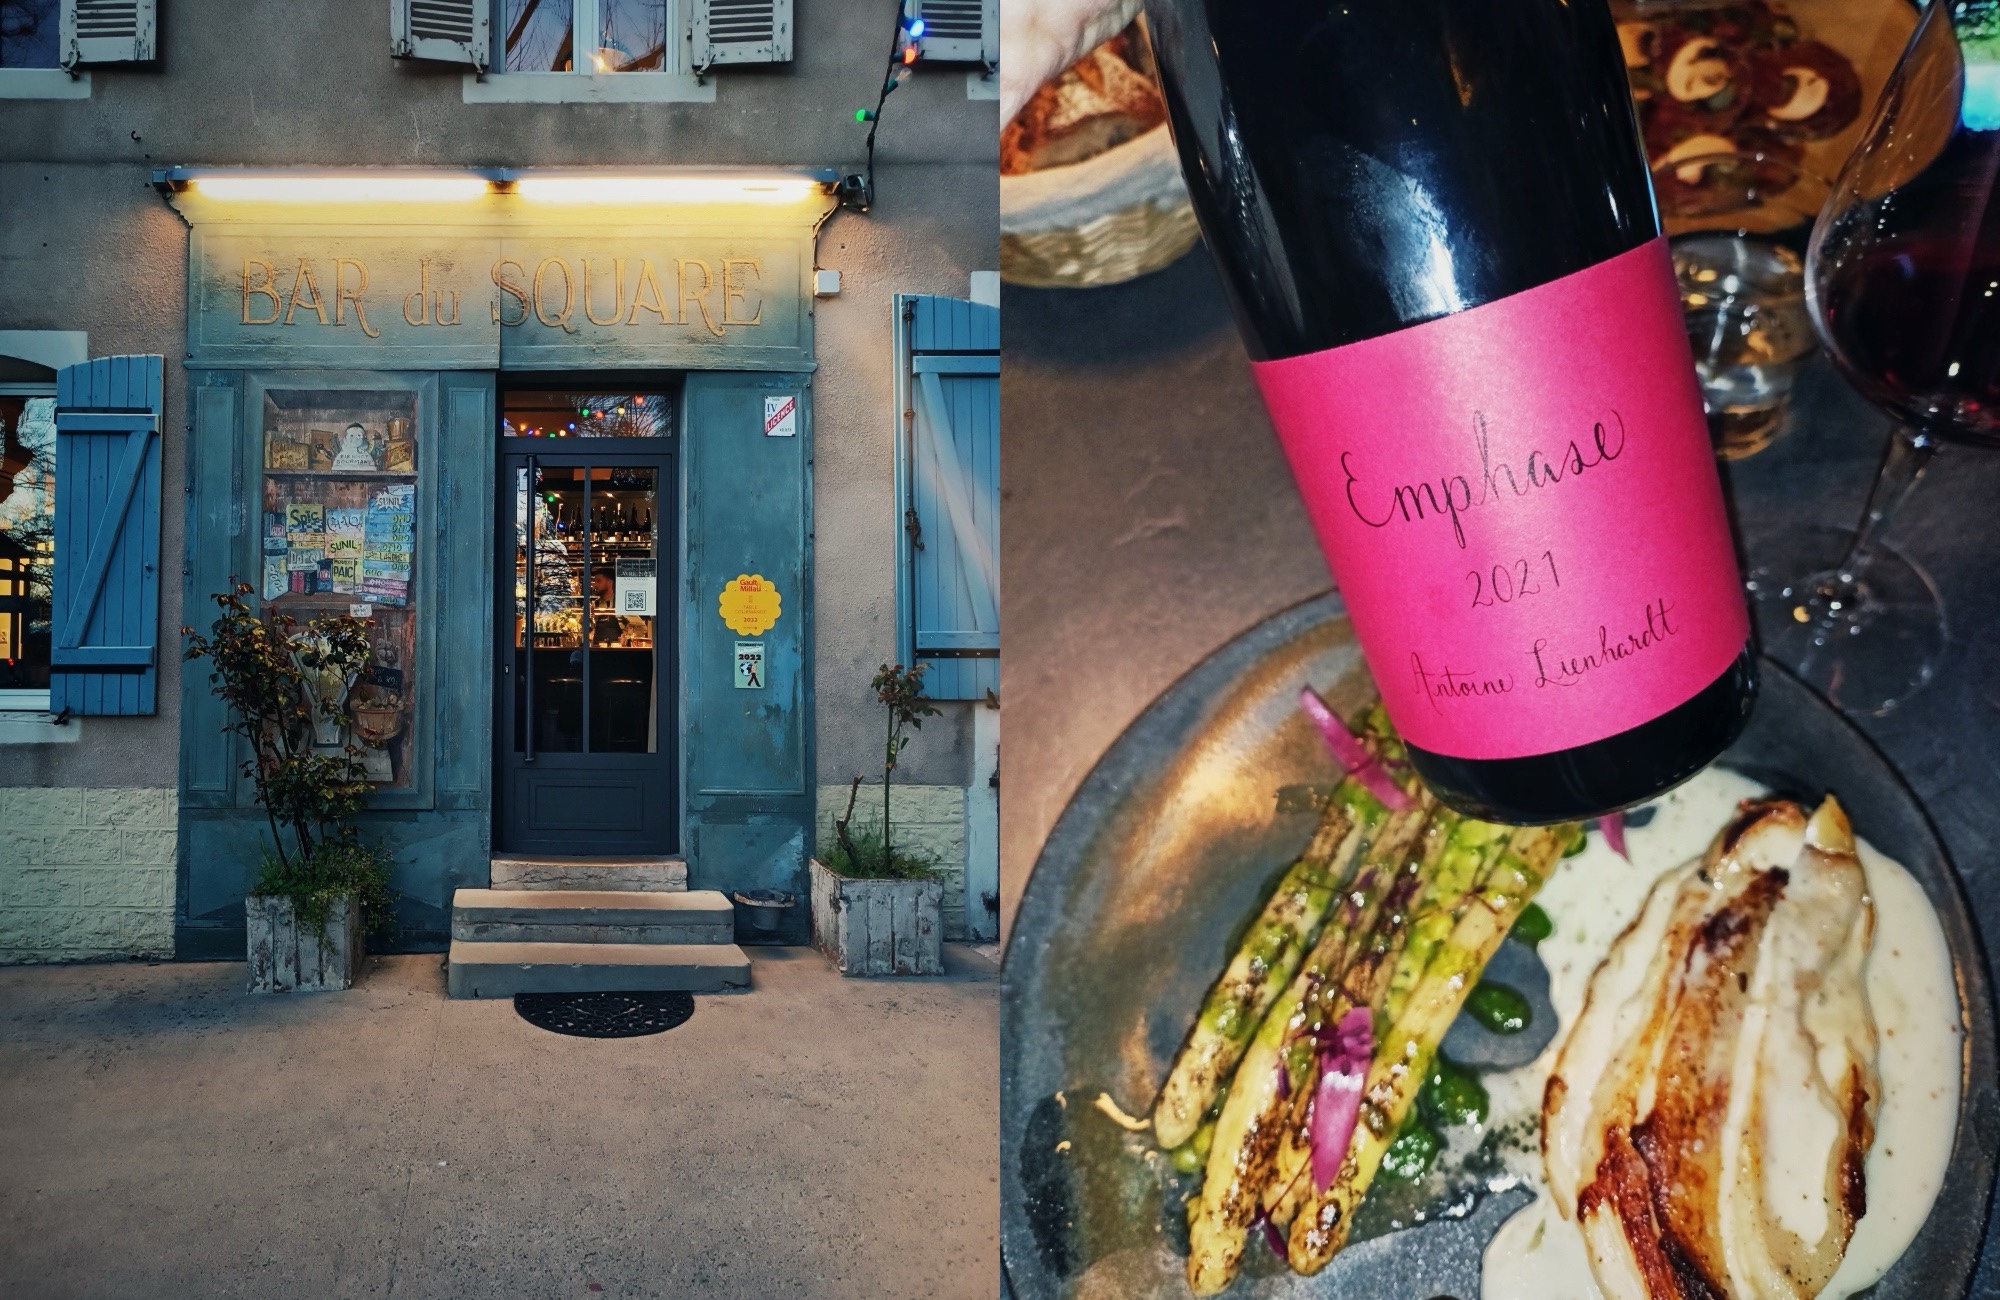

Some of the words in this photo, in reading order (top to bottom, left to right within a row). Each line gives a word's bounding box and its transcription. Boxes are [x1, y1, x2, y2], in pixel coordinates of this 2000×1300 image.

[240, 256, 381, 338] BAR
[403, 257, 462, 326] du
[490, 256, 762, 338] SQUARE
[766, 401, 794, 432] LICENCE
[767, 403, 778, 412] IV
[1340, 409, 1625, 549] Emphase
[378, 497, 401, 507] SUNIL
[290, 509, 320, 530] Spic
[331, 540, 358, 554] SUNIL
[333, 566, 354, 578] PAIC
[1466, 550, 1561, 609] 2021
[1410, 651, 1514, 716] Antoine
[1524, 598, 1678, 688] Lienhardt
